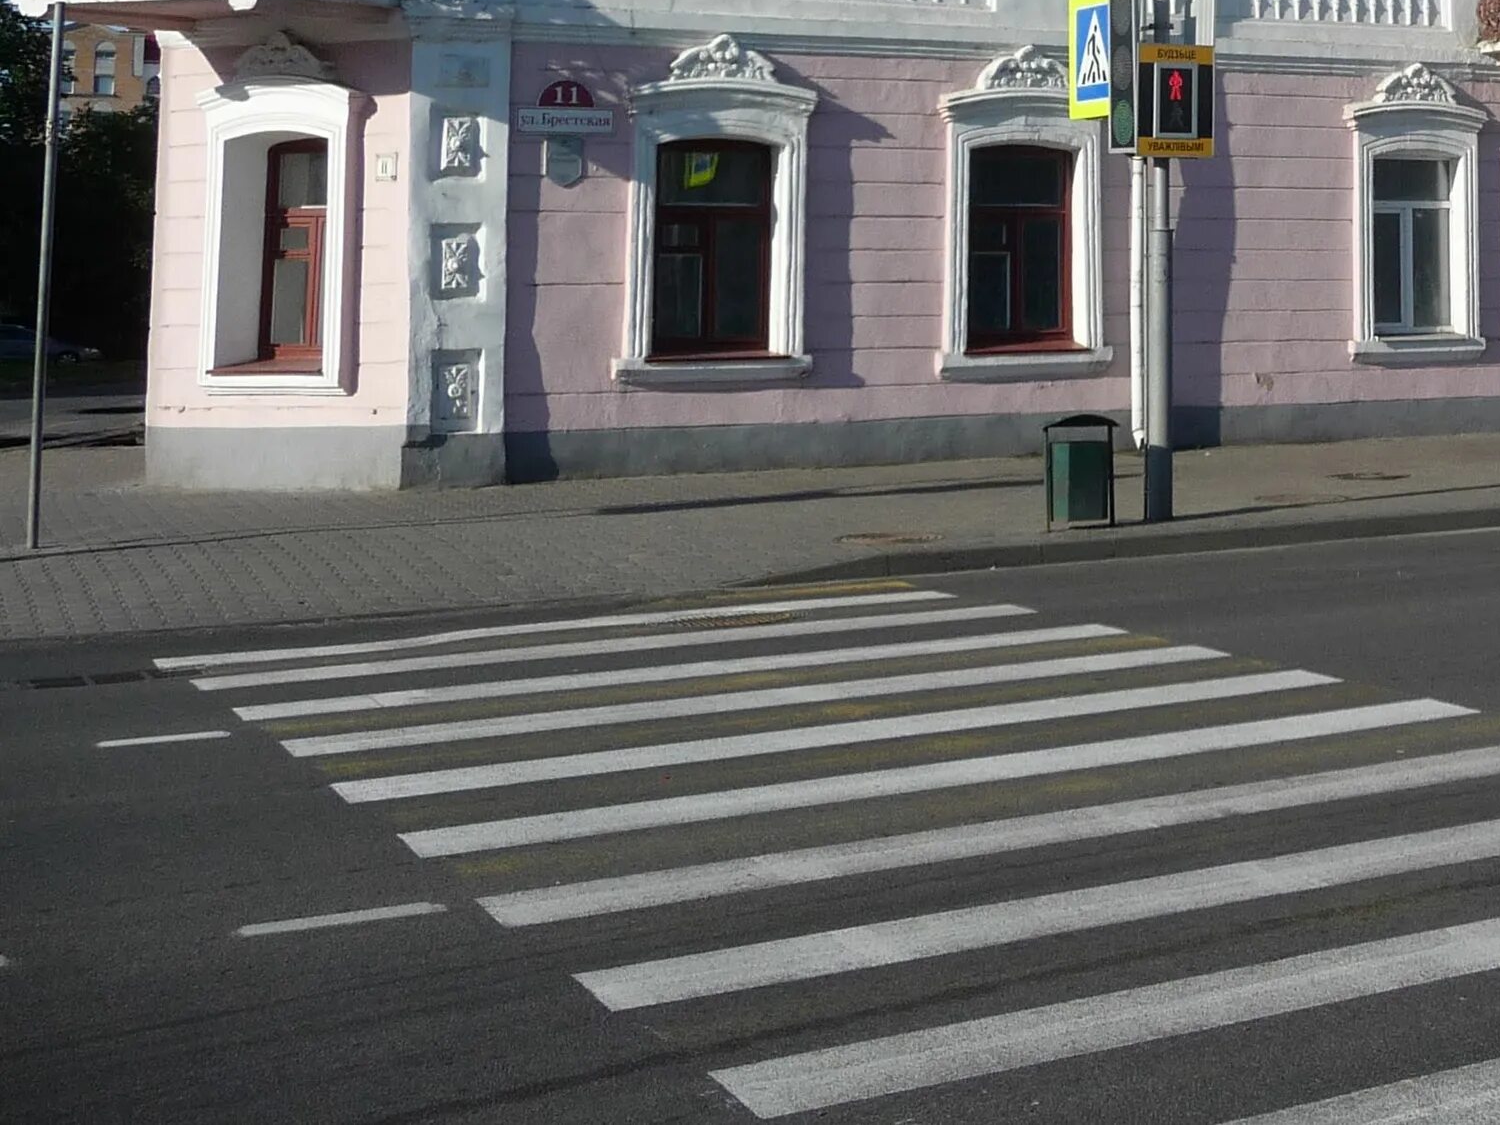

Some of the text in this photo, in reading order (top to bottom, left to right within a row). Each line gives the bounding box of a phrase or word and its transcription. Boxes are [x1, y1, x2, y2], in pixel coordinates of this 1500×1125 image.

[1157, 48, 1197, 61] БУДЗЬЦЕ
[554, 86, 578, 104] 11
[542, 112, 610, 127] Брестская
